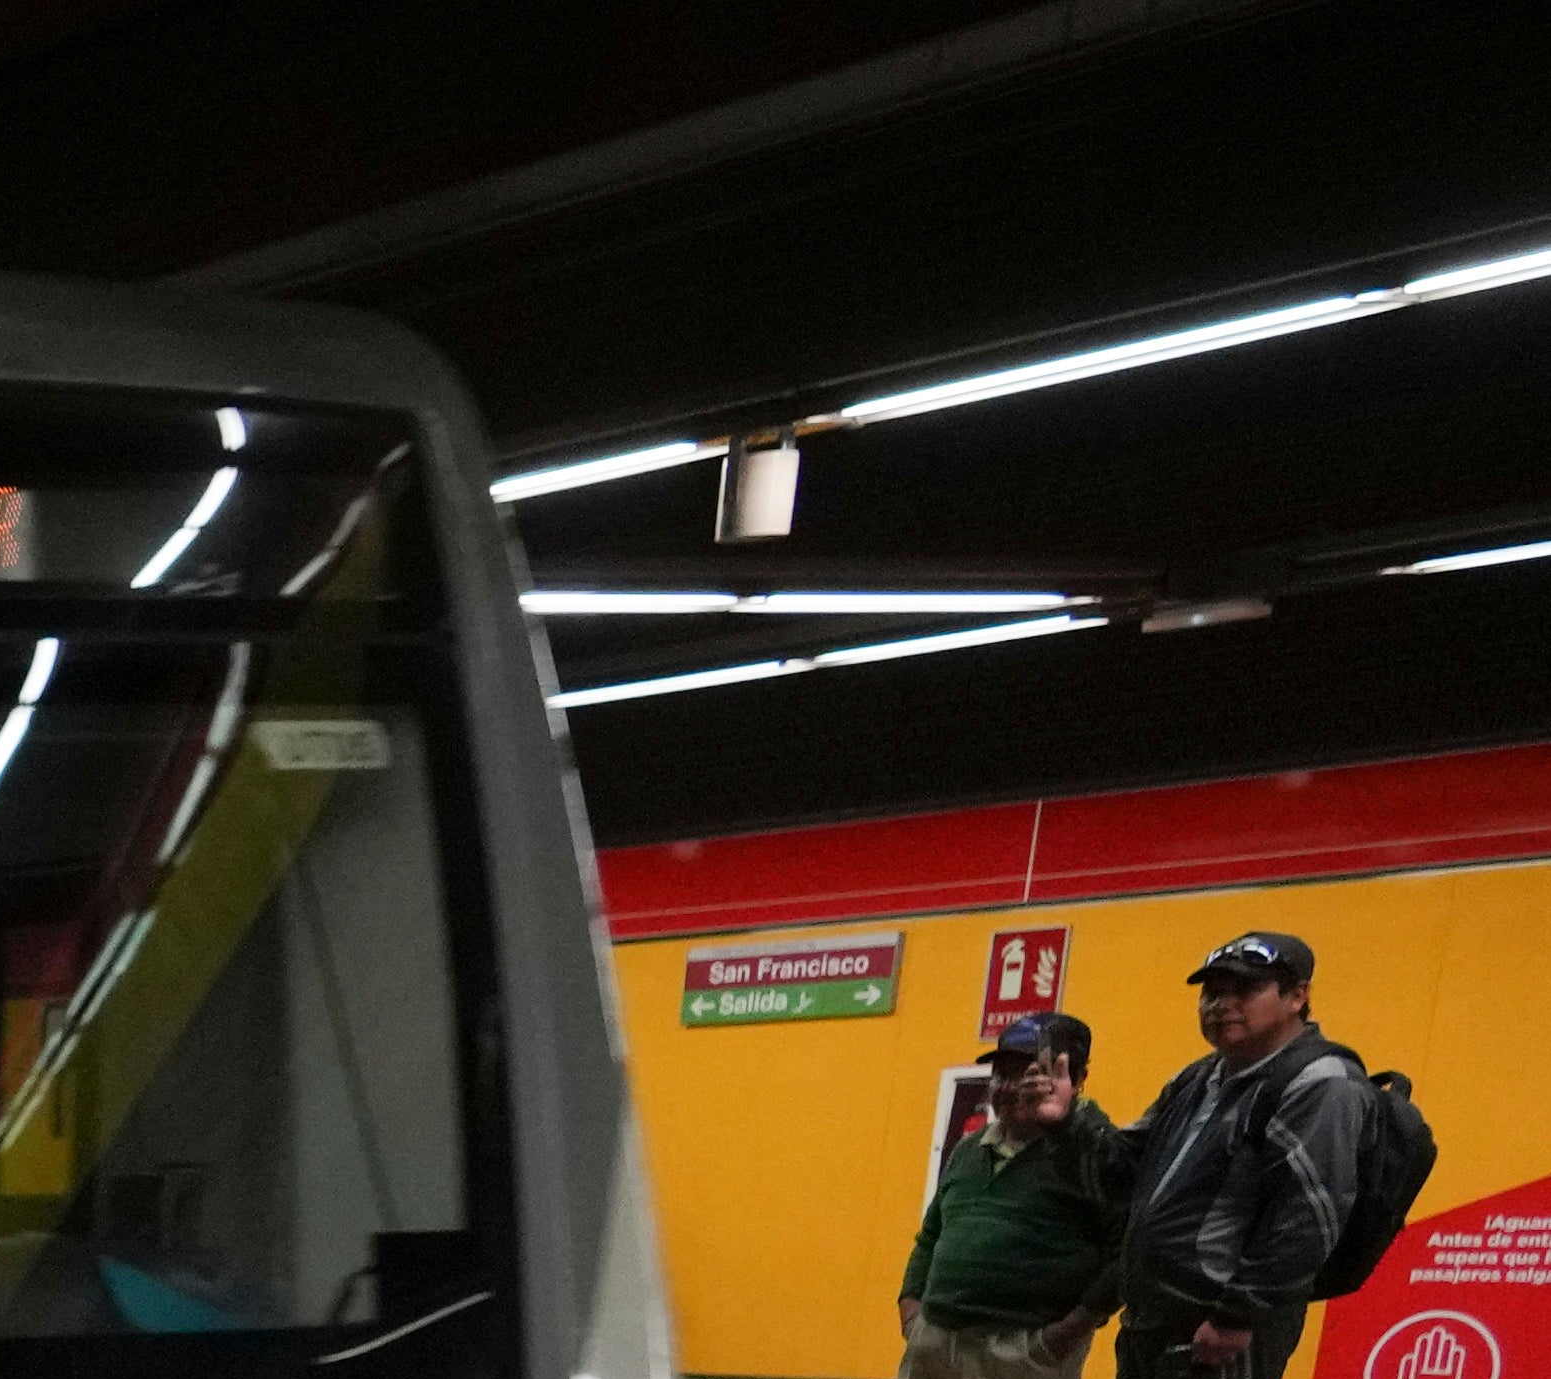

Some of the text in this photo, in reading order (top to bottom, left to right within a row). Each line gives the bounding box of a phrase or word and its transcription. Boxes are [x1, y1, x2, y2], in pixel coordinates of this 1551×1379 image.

[709, 953, 869, 985] San Francisco
[719, 989, 788, 1016] Salida
[1427, 1230, 1551, 1248] Antes de ent
[1434, 1251, 1498, 1267] espera
[1503, 1252, 1540, 1267] que
[1409, 1265, 1501, 1285] pasajeros
